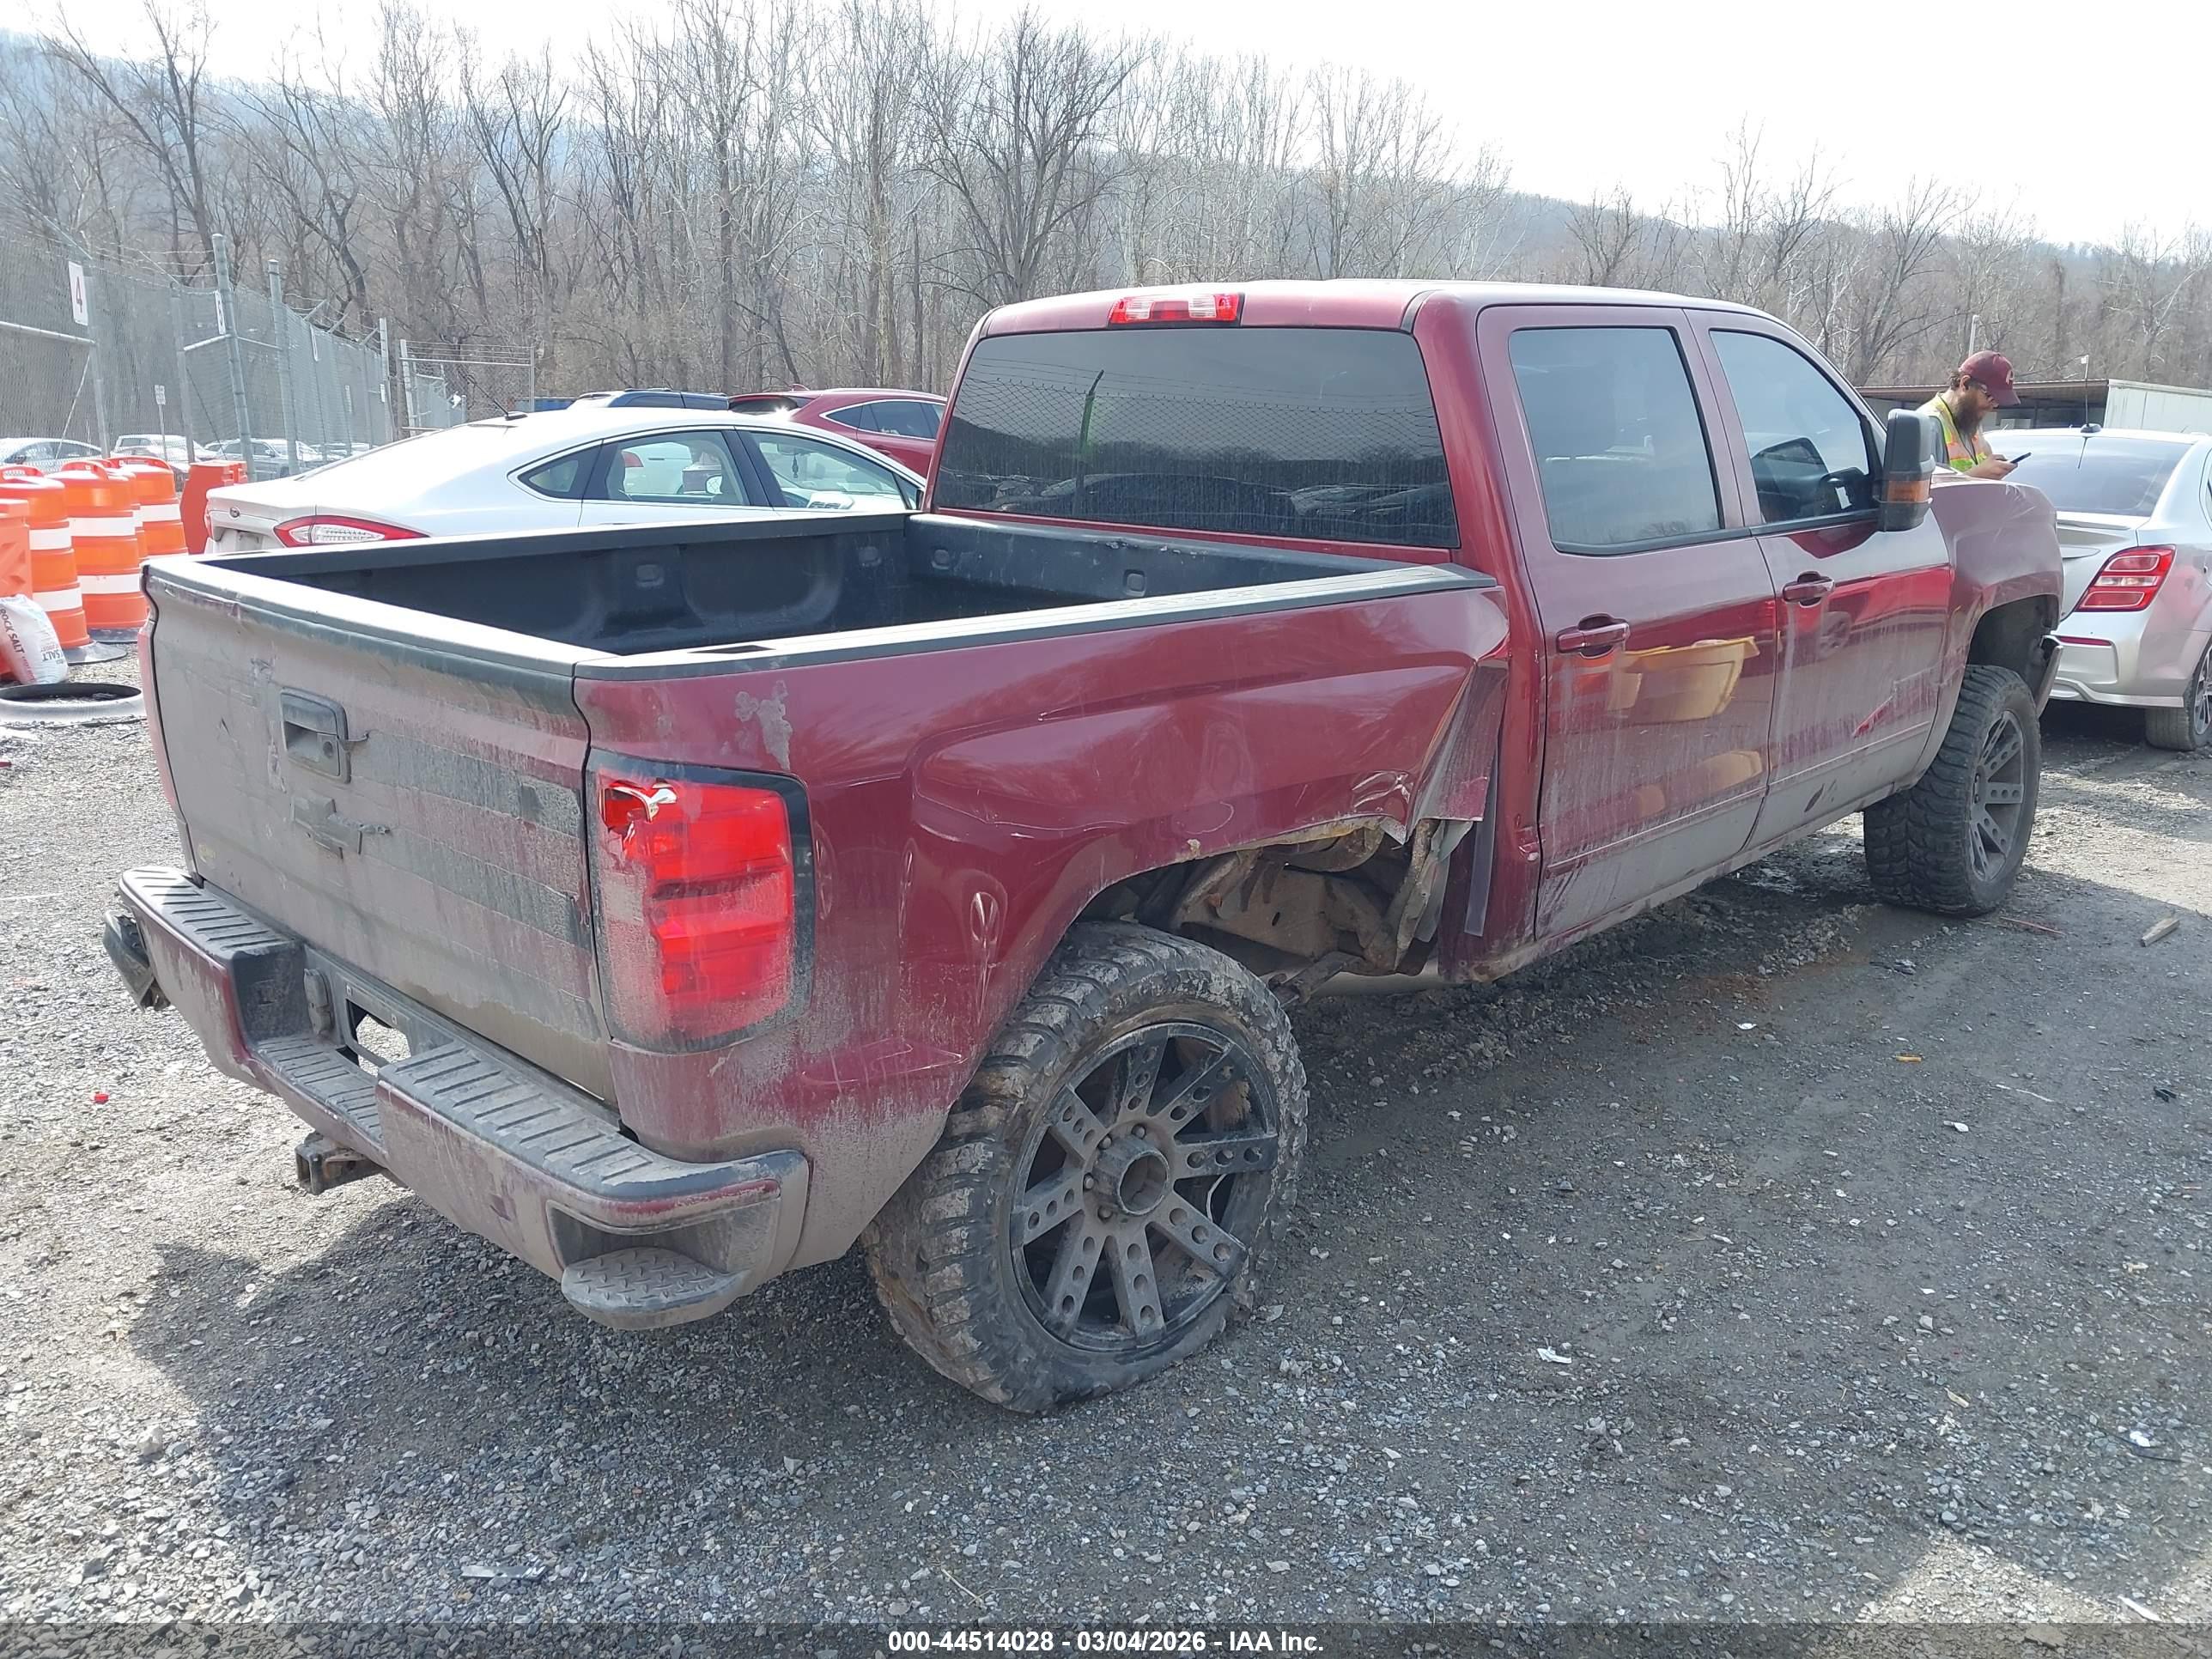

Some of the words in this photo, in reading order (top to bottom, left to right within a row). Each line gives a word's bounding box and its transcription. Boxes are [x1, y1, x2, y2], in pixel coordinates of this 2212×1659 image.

[76, 276, 83, 313] 4
[0, 608, 15, 633] ROCK
[8, 633, 25, 653] SALT
